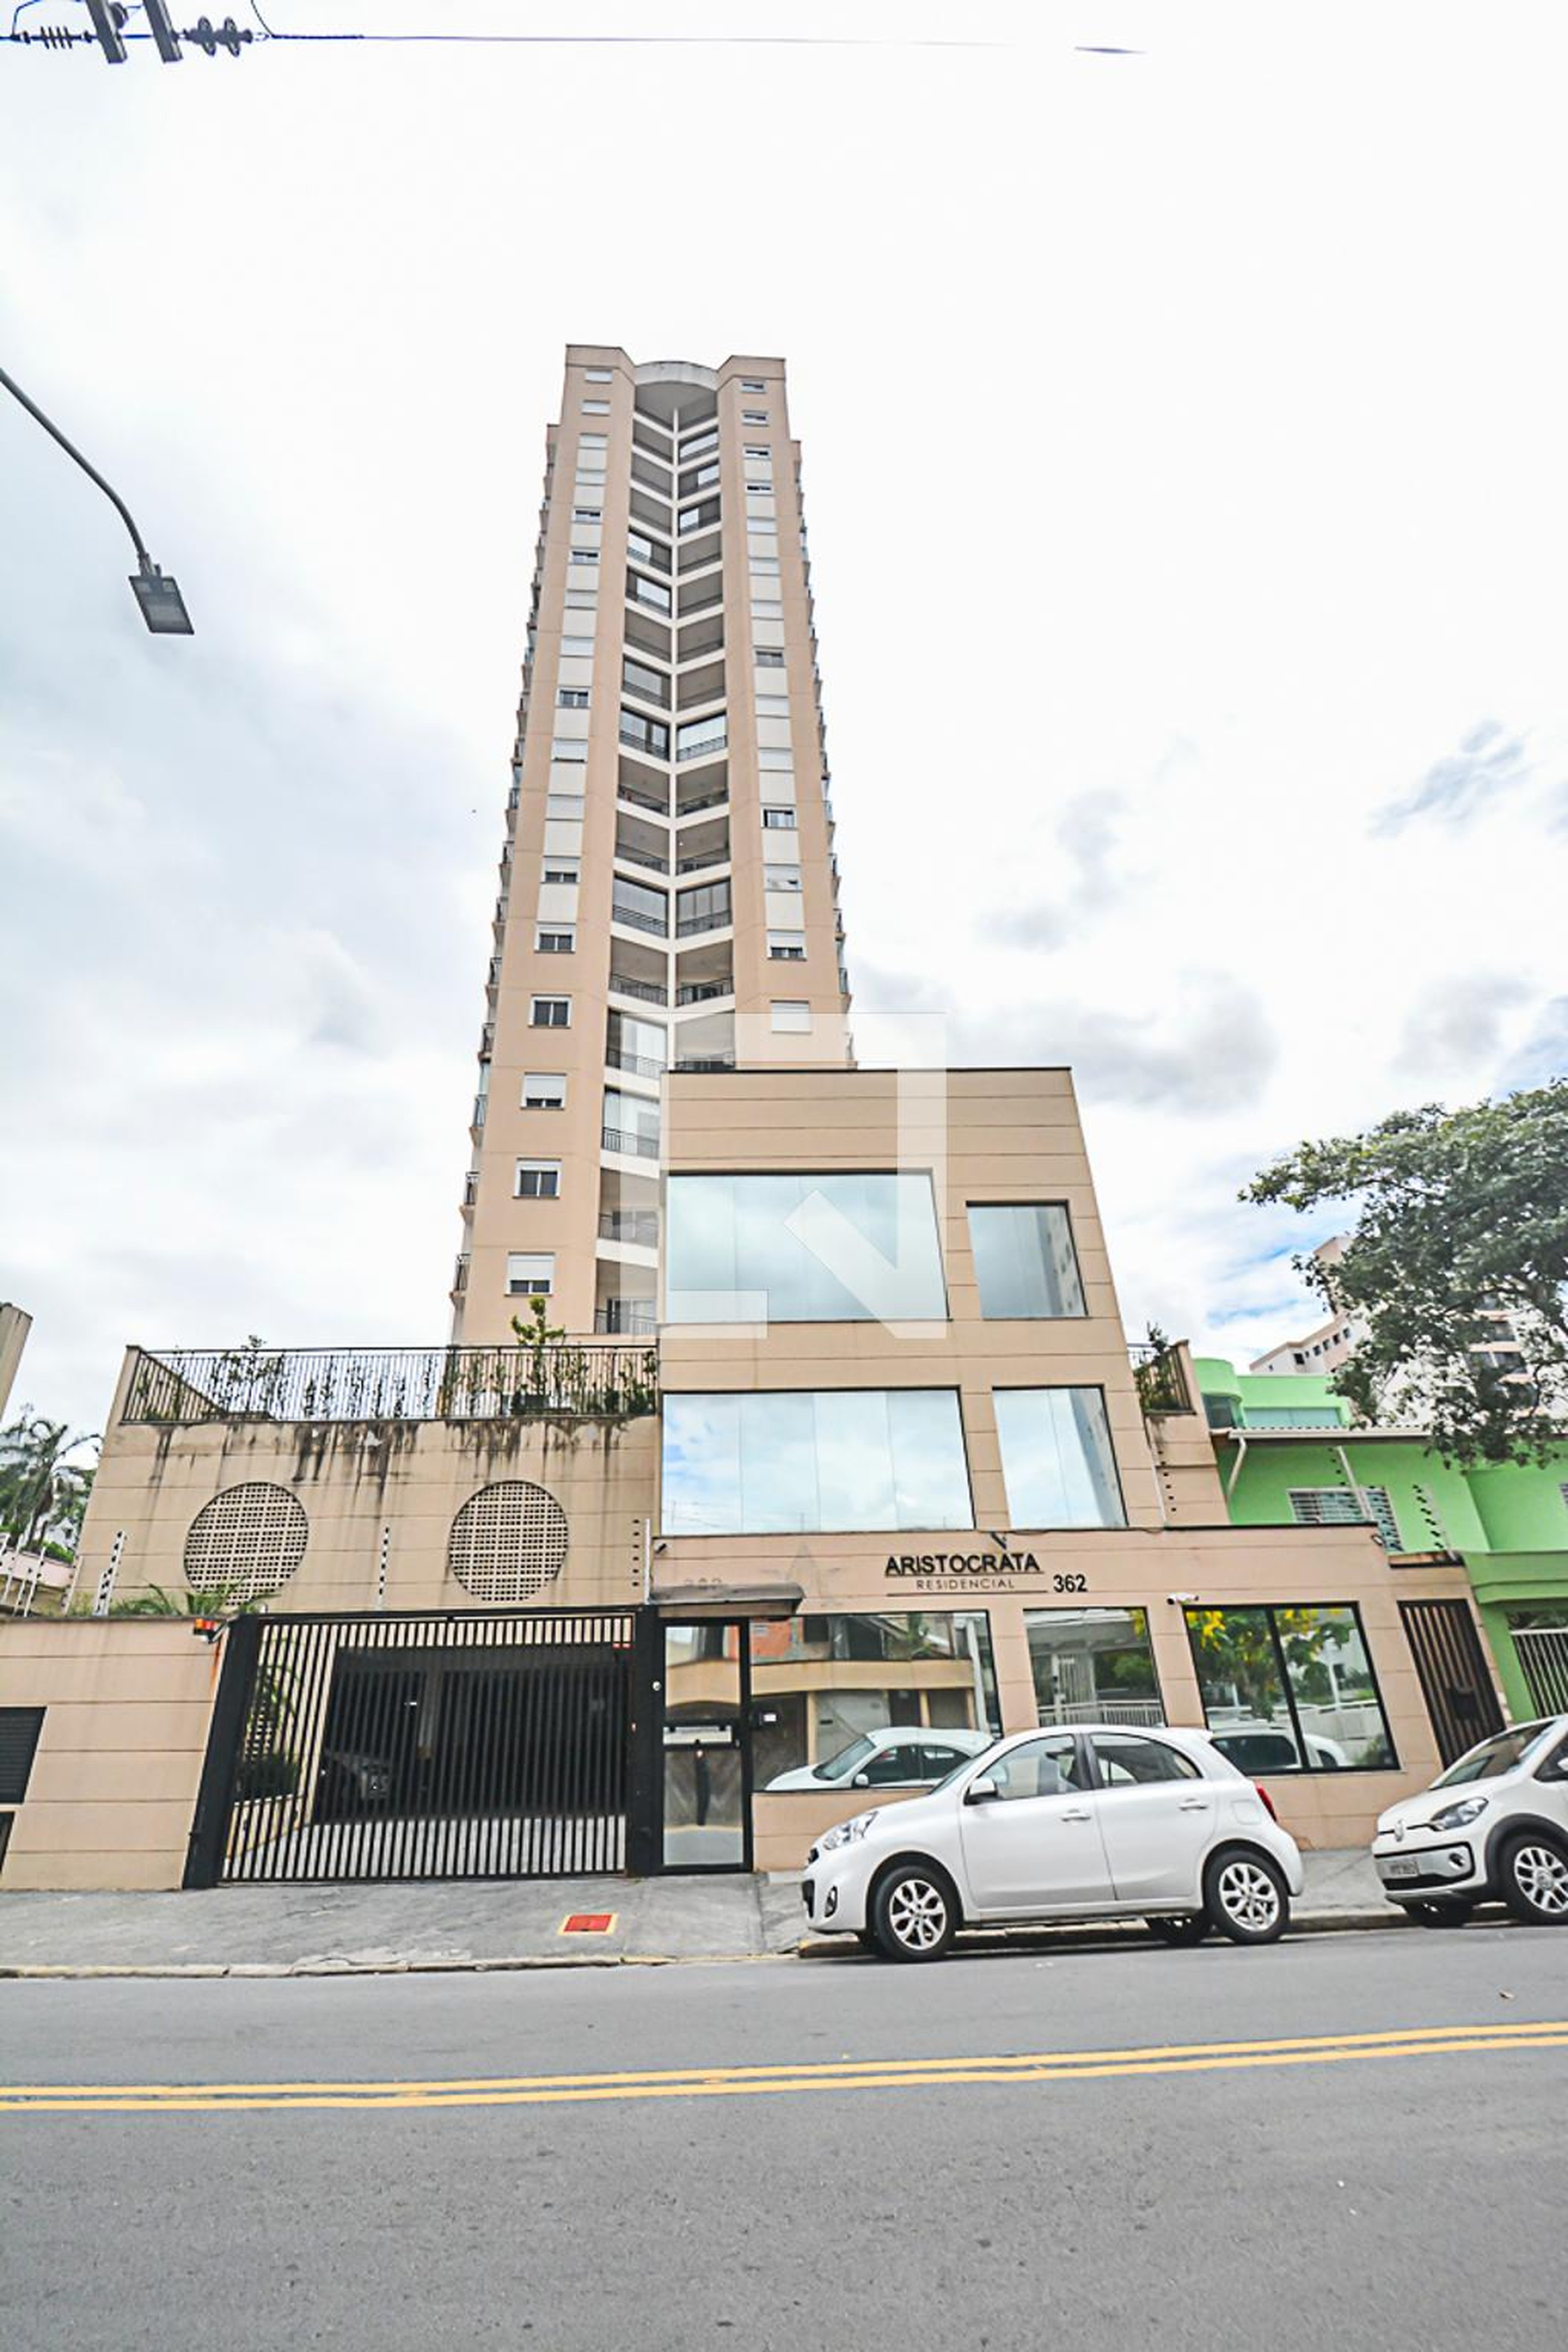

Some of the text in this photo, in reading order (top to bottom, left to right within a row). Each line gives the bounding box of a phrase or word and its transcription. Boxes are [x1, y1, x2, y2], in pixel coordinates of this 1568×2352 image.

[885, 1553, 1040, 1575] ARISTOCRATA
[916, 1579, 1015, 1590] RESIDENCIAL
[1053, 1574, 1087, 1592] 362
